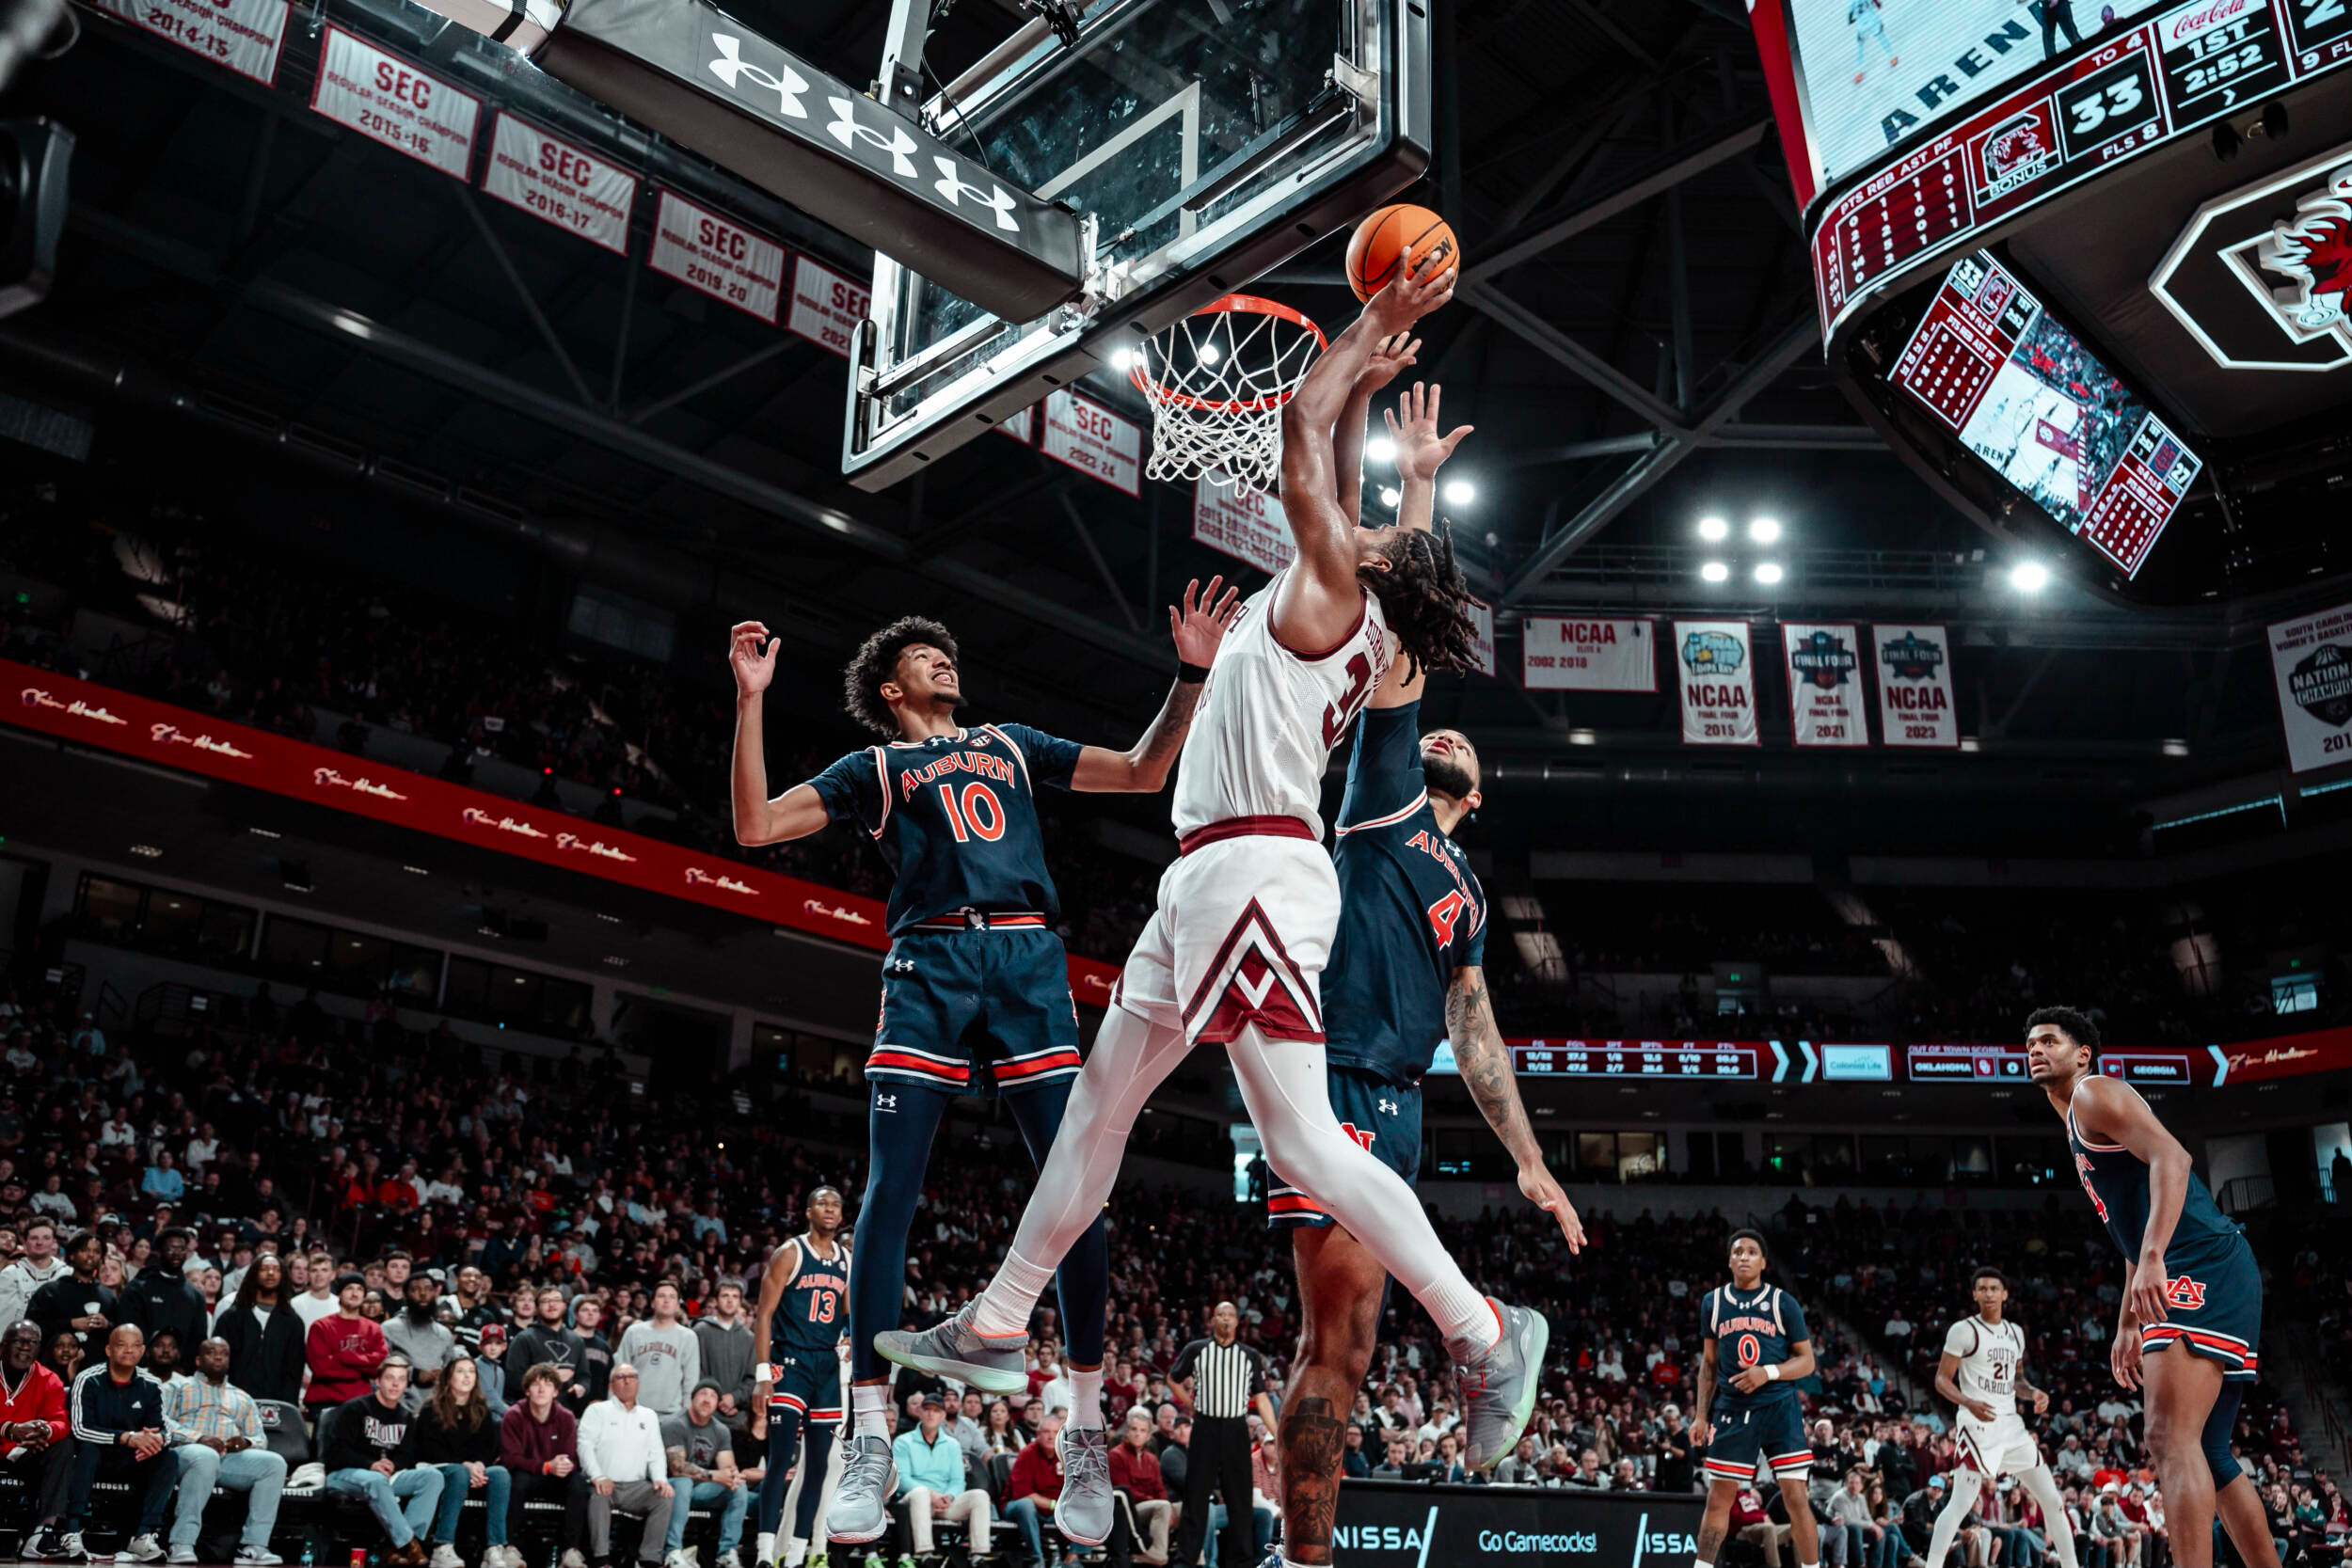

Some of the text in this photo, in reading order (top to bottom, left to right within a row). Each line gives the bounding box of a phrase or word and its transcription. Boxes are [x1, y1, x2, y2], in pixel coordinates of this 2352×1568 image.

[148, 8, 228, 56] 2014-15
[216, 14, 275, 49] CHAMPION
[2187, 17, 2249, 59] 1ST
[2091, 32, 2143, 67] TO 4
[2301, 40, 2352, 71] 9 FL
[1881, 6, 2040, 144] AREN
[2184, 43, 2264, 94] 2:52
[374, 60, 431, 109] SEC
[327, 71, 468, 146] REGULAR SEASON CHAMPION
[2072, 73, 2142, 134] 33
[359, 109, 430, 152] 2015-16
[2102, 122, 2159, 160] FLS 8
[539, 142, 591, 187] SEC
[1840, 136, 1952, 215] PTS REB AST PF
[1989, 160, 2047, 198] BONUS
[497, 152, 625, 221] REGULAR SEASON CHAMPION
[1849, 214, 1858, 228] 0
[1880, 197, 1887, 208] 1
[1913, 177, 1920, 188] 1
[1942, 159, 1950, 170] 1
[526, 190, 590, 229] 2016-17
[1851, 173, 1954, 243] 2 1 1 0
[1852, 243, 1861, 256] 7
[1882, 225, 1891, 238] 2
[1914, 205, 1925, 217] 0
[1946, 188, 1955, 199] 1
[699, 218, 746, 261] SEC
[1851, 255, 1866, 272] 14
[1883, 239, 1893, 251] 5
[1915, 219, 1927, 232] 0
[1947, 202, 1957, 214] 1
[1854, 217, 1959, 284] 0 2 1 1
[660, 228, 776, 291] REGULAR SEASON CHAMPION
[1959, 259, 1984, 290] 33
[687, 263, 746, 302] 2019-20
[832, 282, 871, 320] SEC
[1077, 405, 1111, 441] SEC
[1975, 442, 2006, 463] AREN
[2170, 462, 2191, 484] 27
[1235, 485, 1263, 515] SEC
[1561, 623, 1616, 644] NCAA
[2285, 612, 2352, 639] SOUTH CAROLI
[1883, 649, 1941, 661] FINAL FOUR
[2276, 634, 2315, 652] WOMEN'S
[1528, 656, 1587, 668] 2002 2018
[1794, 655, 1852, 667] FINAL FOUR
[2293, 662, 2352, 690] NATION
[1688, 685, 1747, 707] NCAA
[1815, 695, 1841, 705] NCAA
[1887, 687, 1947, 709] NCAA
[1697, 710, 1739, 720] FINAL FOUR
[1808, 708, 1828, 718] FINAL
[1898, 712, 1940, 721] FINAL FOUR
[970, 736, 992, 747] SEC
[1704, 724, 1736, 736] 2015
[1816, 725, 1845, 737] 2021
[1905, 726, 1936, 738] 2023
[2324, 733, 2352, 753] 201
[900, 752, 1015, 803] AUBURN
[938, 782, 1006, 843] 10
[1405, 830, 1479, 939] AUBURN
[1428, 889, 1466, 951] 4
[1830, 1060, 1882, 1070] Colonial Life
[1915, 1061, 2019, 1074] OKLAHOMA 0
[2133, 1066, 2177, 1075] GEORGIA
[808, 1290, 836, 1323] 13
[1718, 1317, 1776, 1338] AUBURN
[638, 1341, 676, 1358] CAROLINA
[1738, 1334, 1760, 1365] 0
[1987, 1348, 2015, 1363] SOUTH
[1994, 1362, 2009, 1381] 21
[1332, 1528, 1423, 1550] NISSA
[1479, 1530, 1597, 1553] Go Gamecocks!
